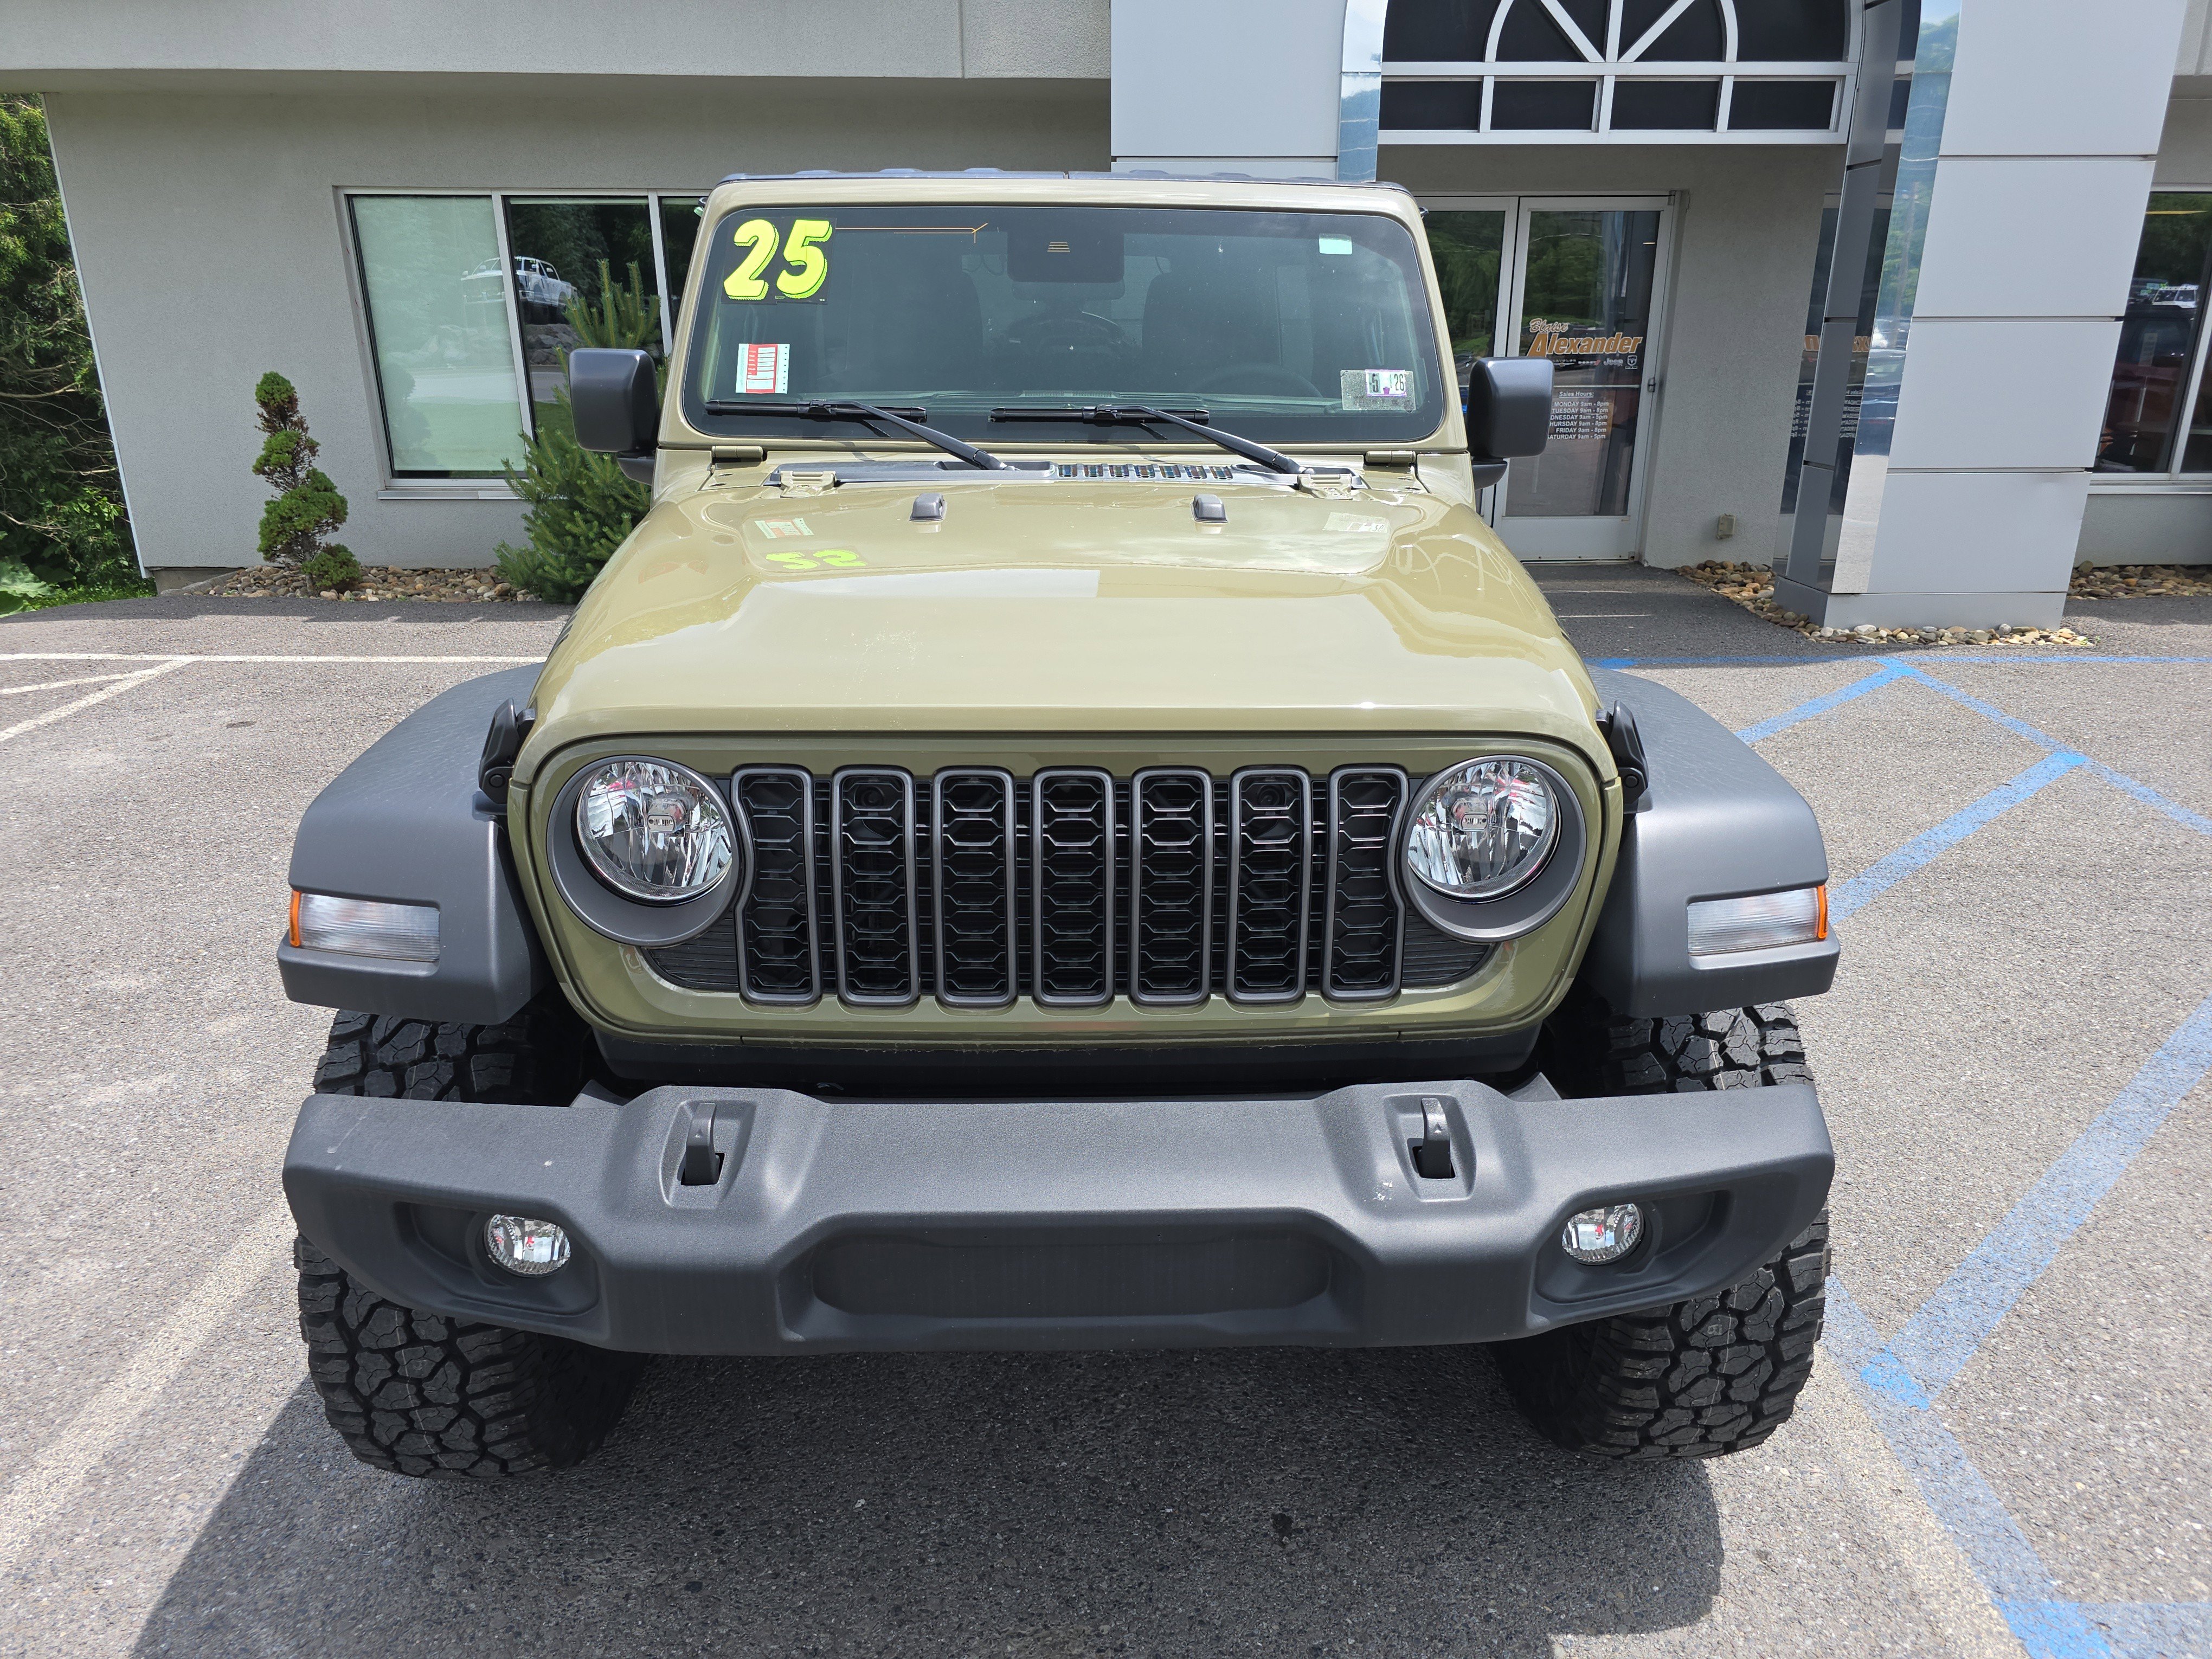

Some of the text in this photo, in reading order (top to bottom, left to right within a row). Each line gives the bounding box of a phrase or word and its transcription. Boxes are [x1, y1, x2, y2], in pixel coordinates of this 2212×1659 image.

[723, 219, 833, 300] 25
[1529, 318, 1569, 333] Blaise
[1526, 332, 1643, 357] Alexander
[1603, 358, 1624, 366] Jeep
[1394, 374, 1405, 391] 26
